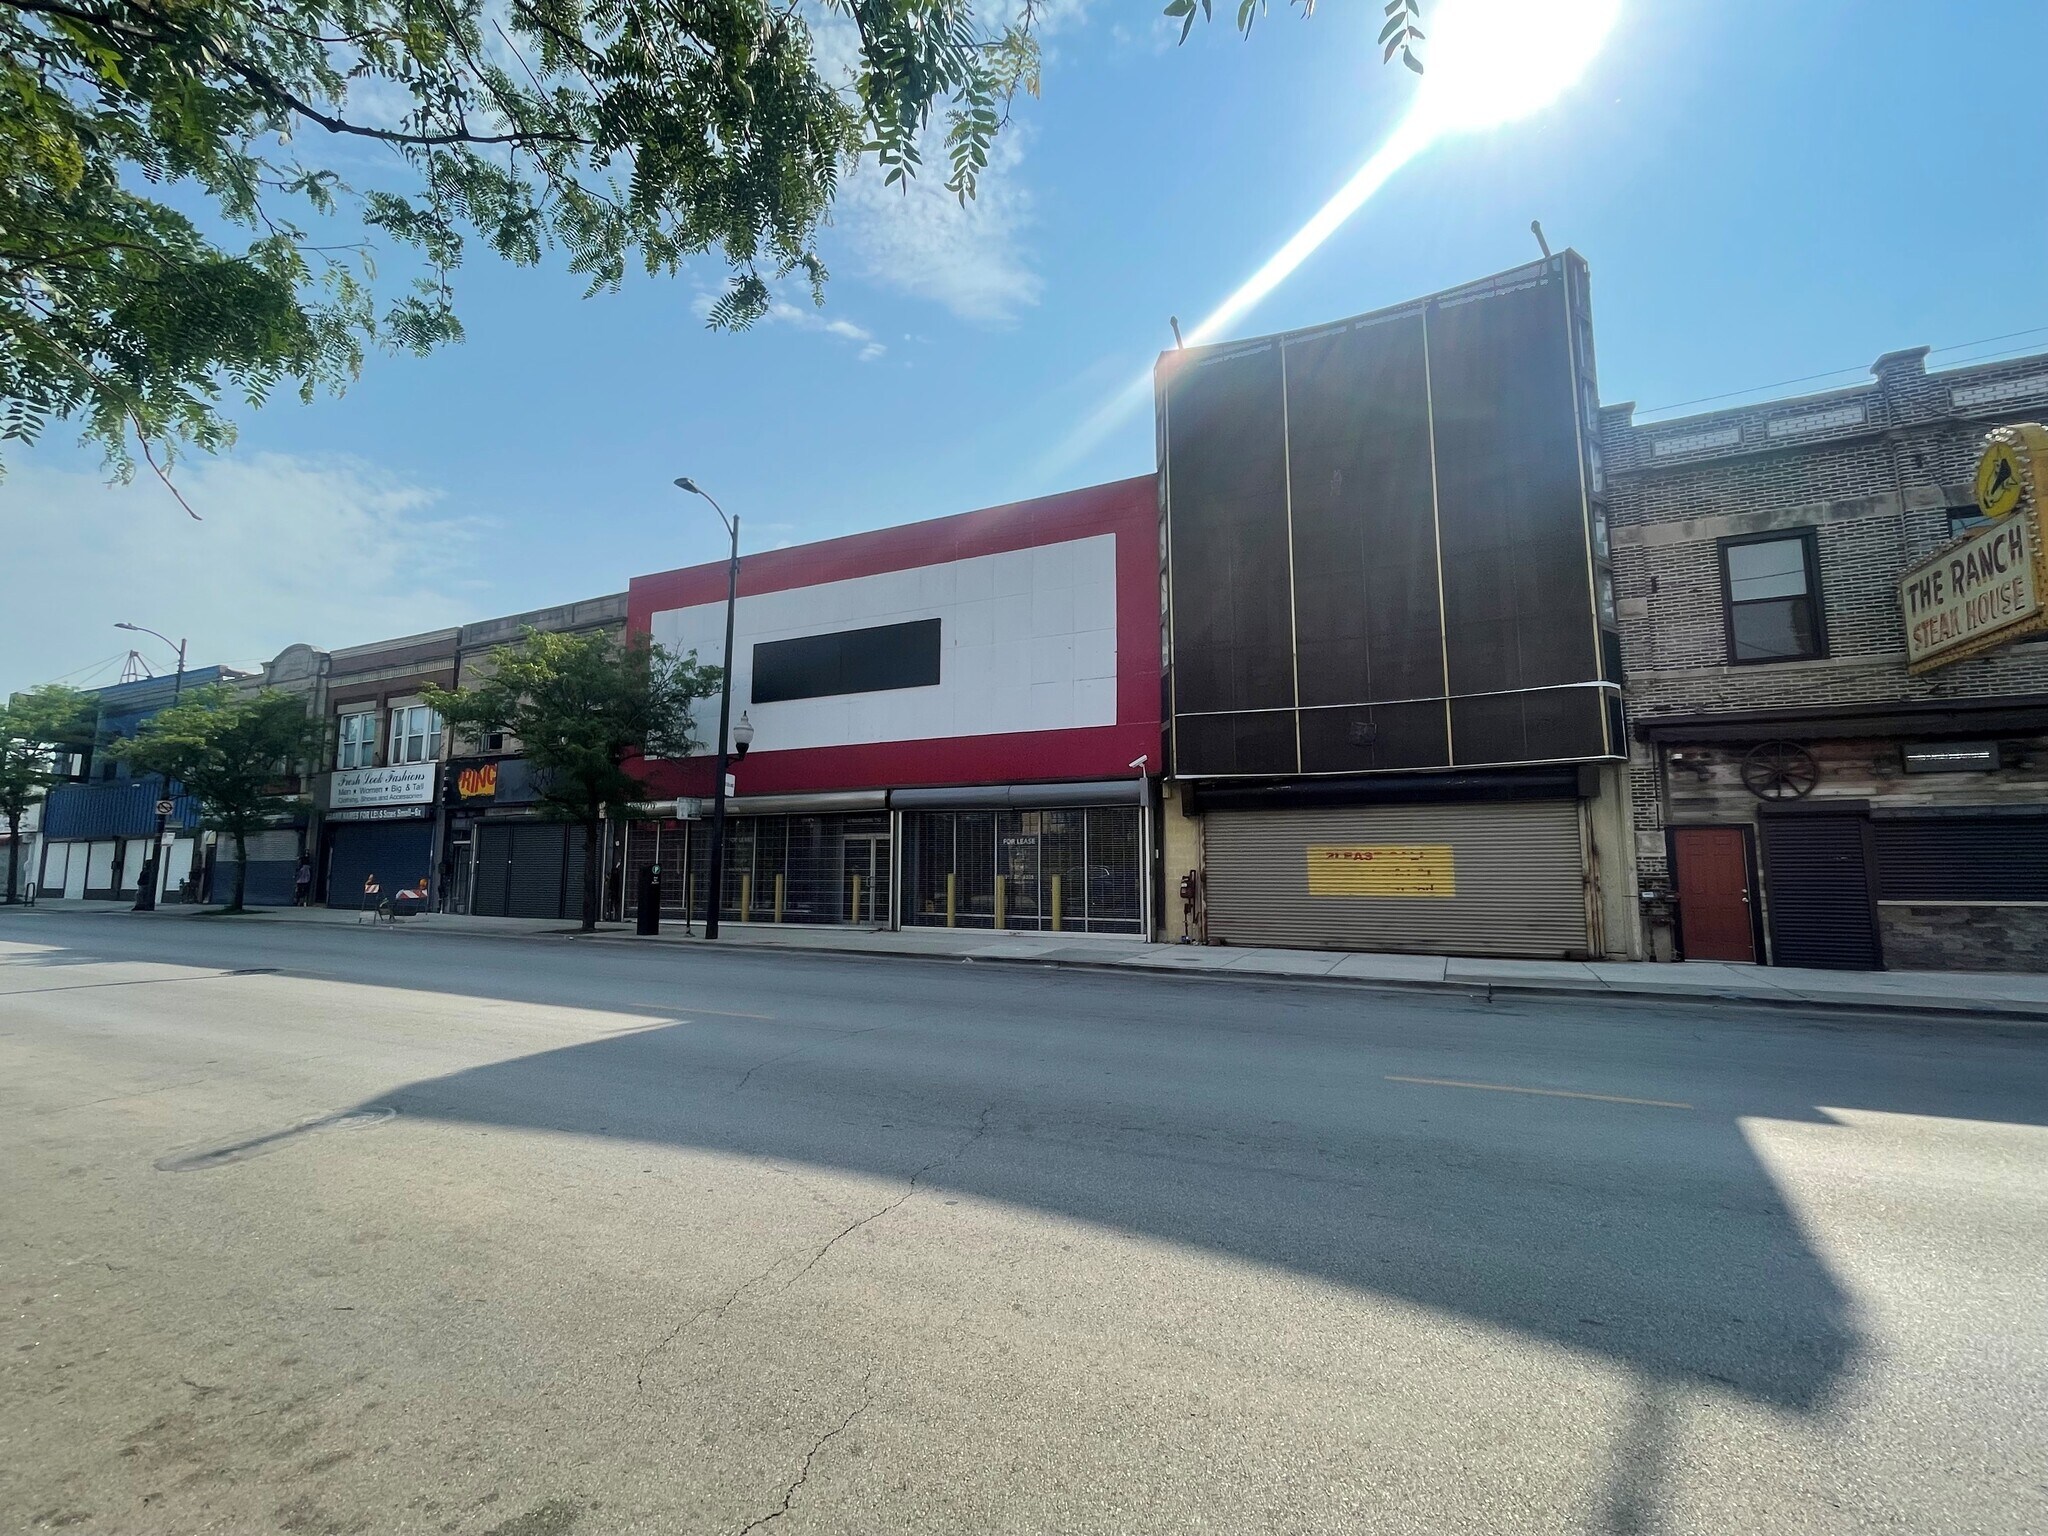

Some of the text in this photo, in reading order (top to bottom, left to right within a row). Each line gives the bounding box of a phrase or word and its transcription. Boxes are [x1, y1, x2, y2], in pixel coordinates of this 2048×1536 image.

[1906, 524, 2025, 618] THE RANCH
[1912, 577, 2026, 652] STEAK HOUSE
[338, 769, 425, 786] Fresh Look Fashions
[338, 782, 424, 796] Men Women Big & Tall
[360, 810, 370, 819] FOR
